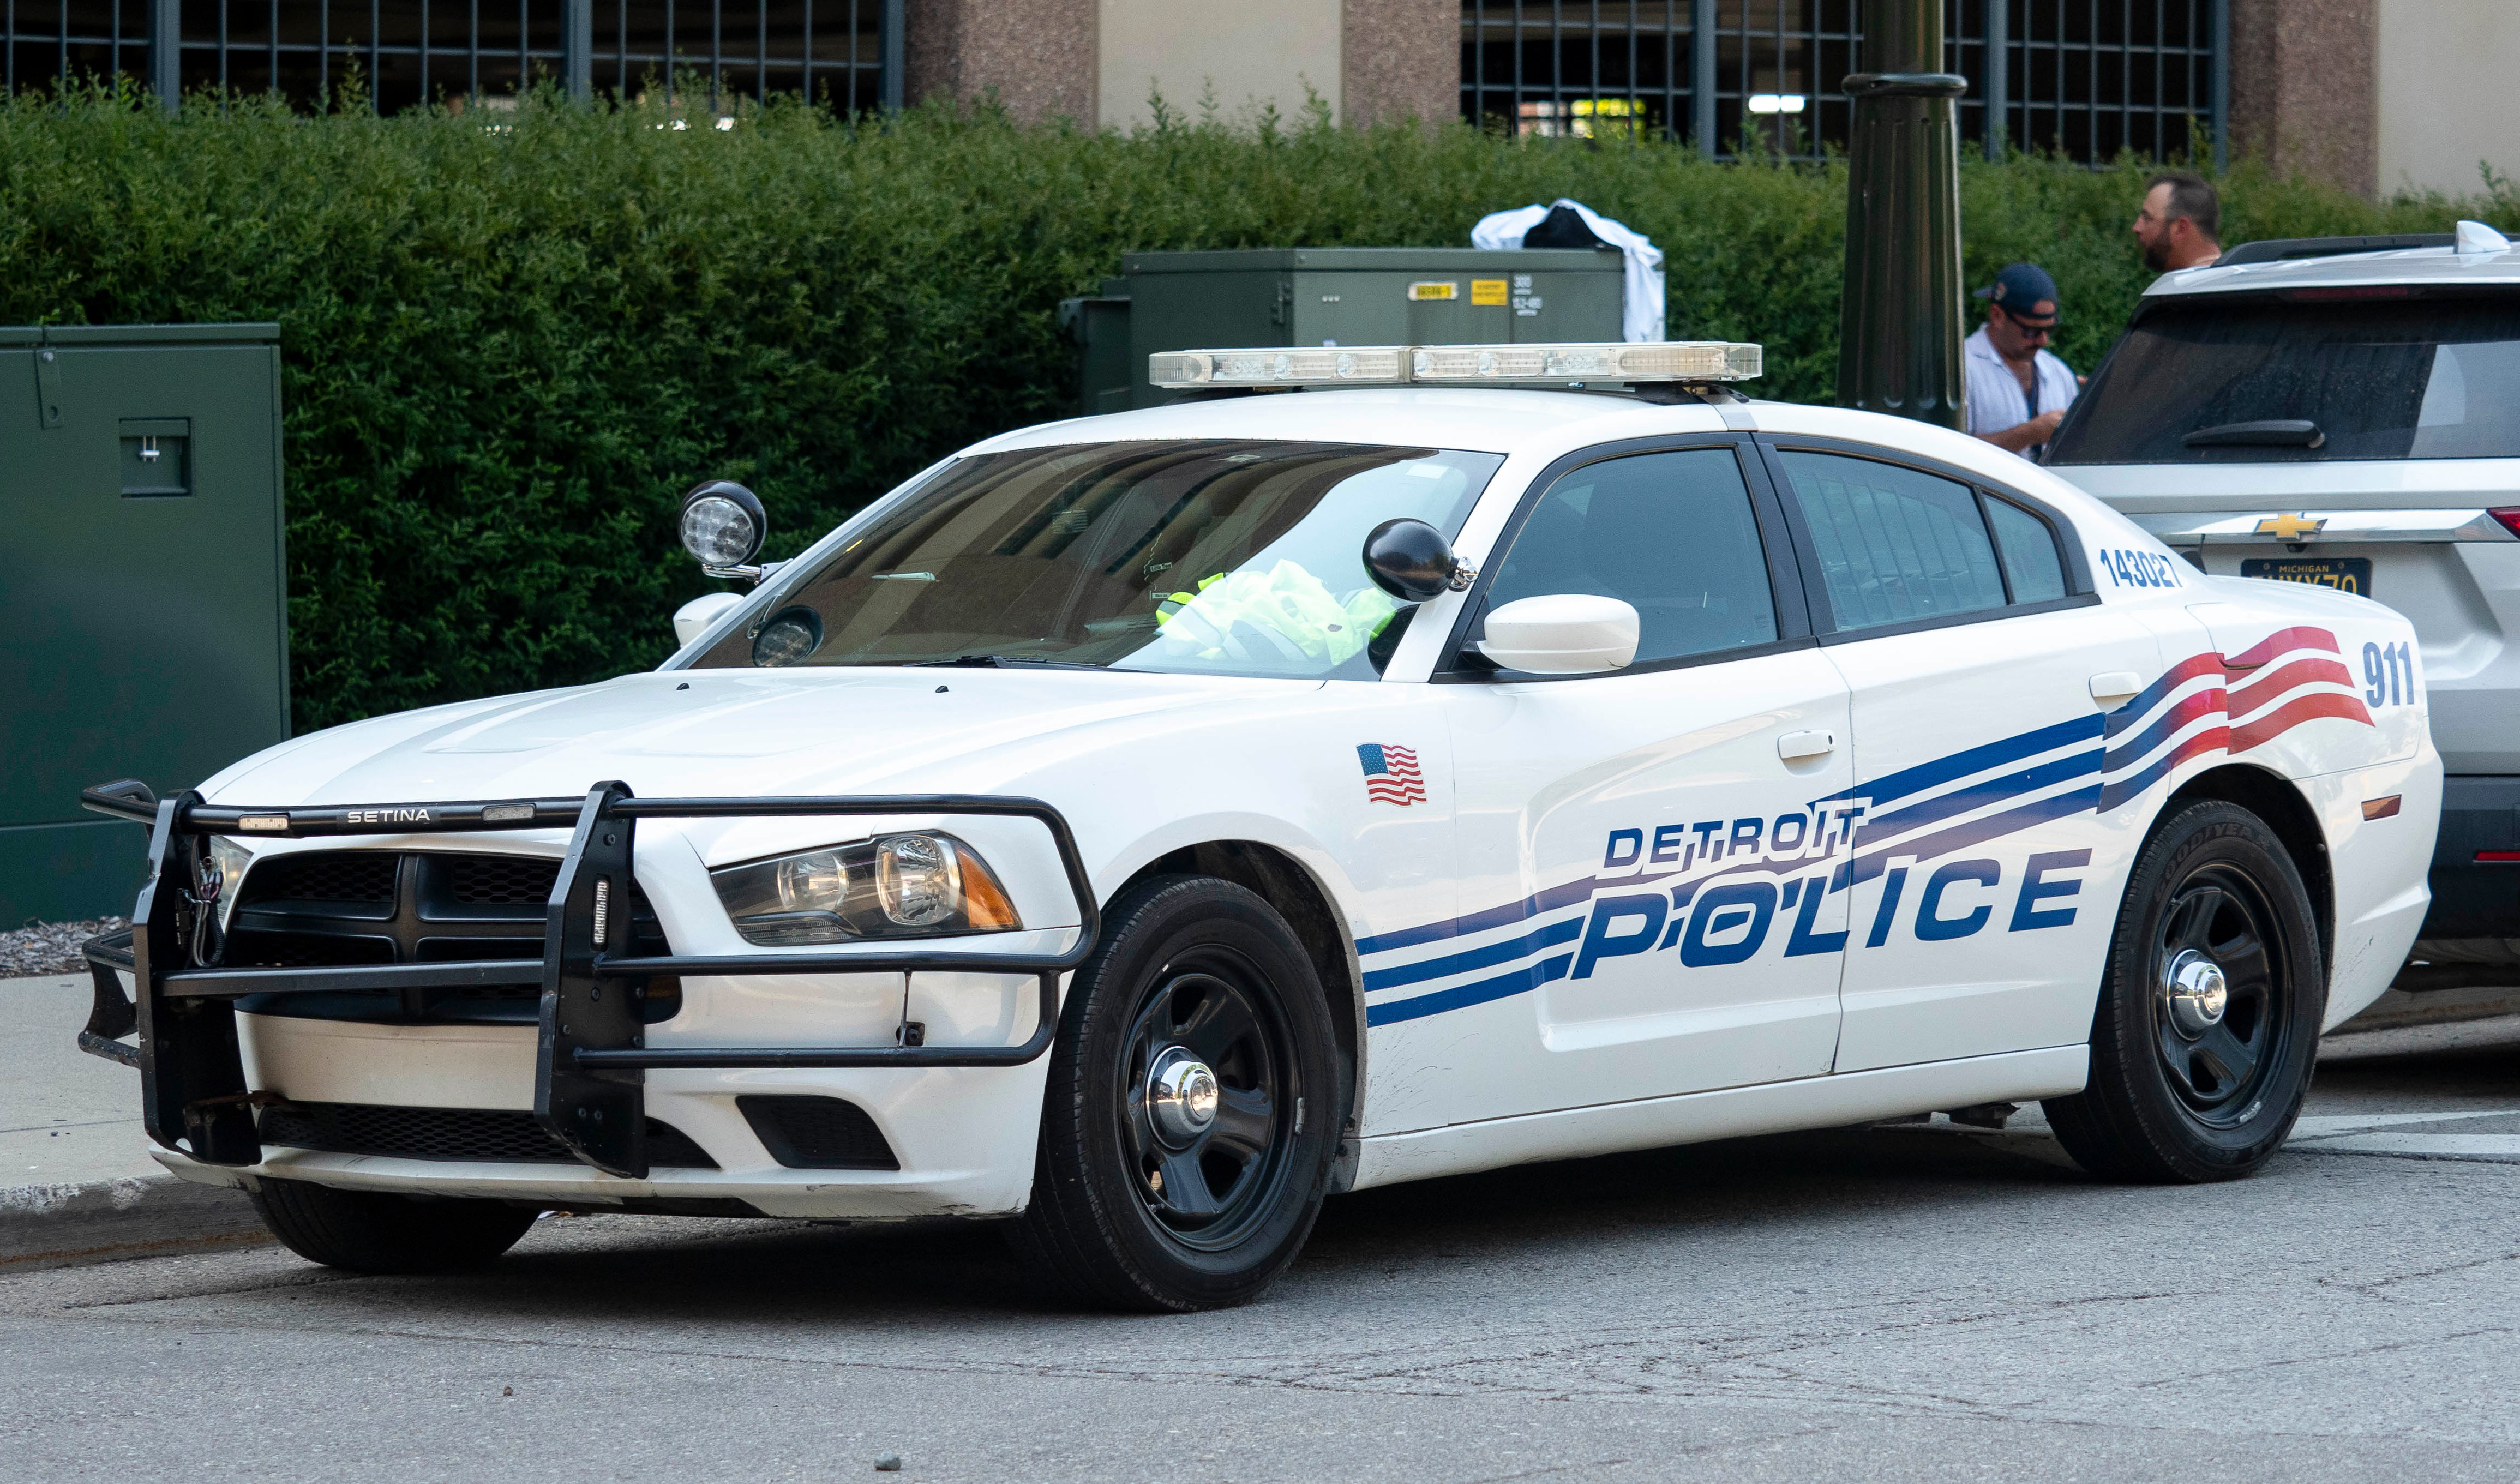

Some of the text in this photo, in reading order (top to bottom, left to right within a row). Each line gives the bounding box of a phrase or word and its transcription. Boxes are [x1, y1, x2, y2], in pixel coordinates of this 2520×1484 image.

[2101, 549, 2183, 587] 143027
[2362, 641, 2414, 708] 911
[347, 809, 430, 823] SETINA
[1604, 806, 1865, 868] DETROIT
[1571, 848, 2092, 980] POLICE
